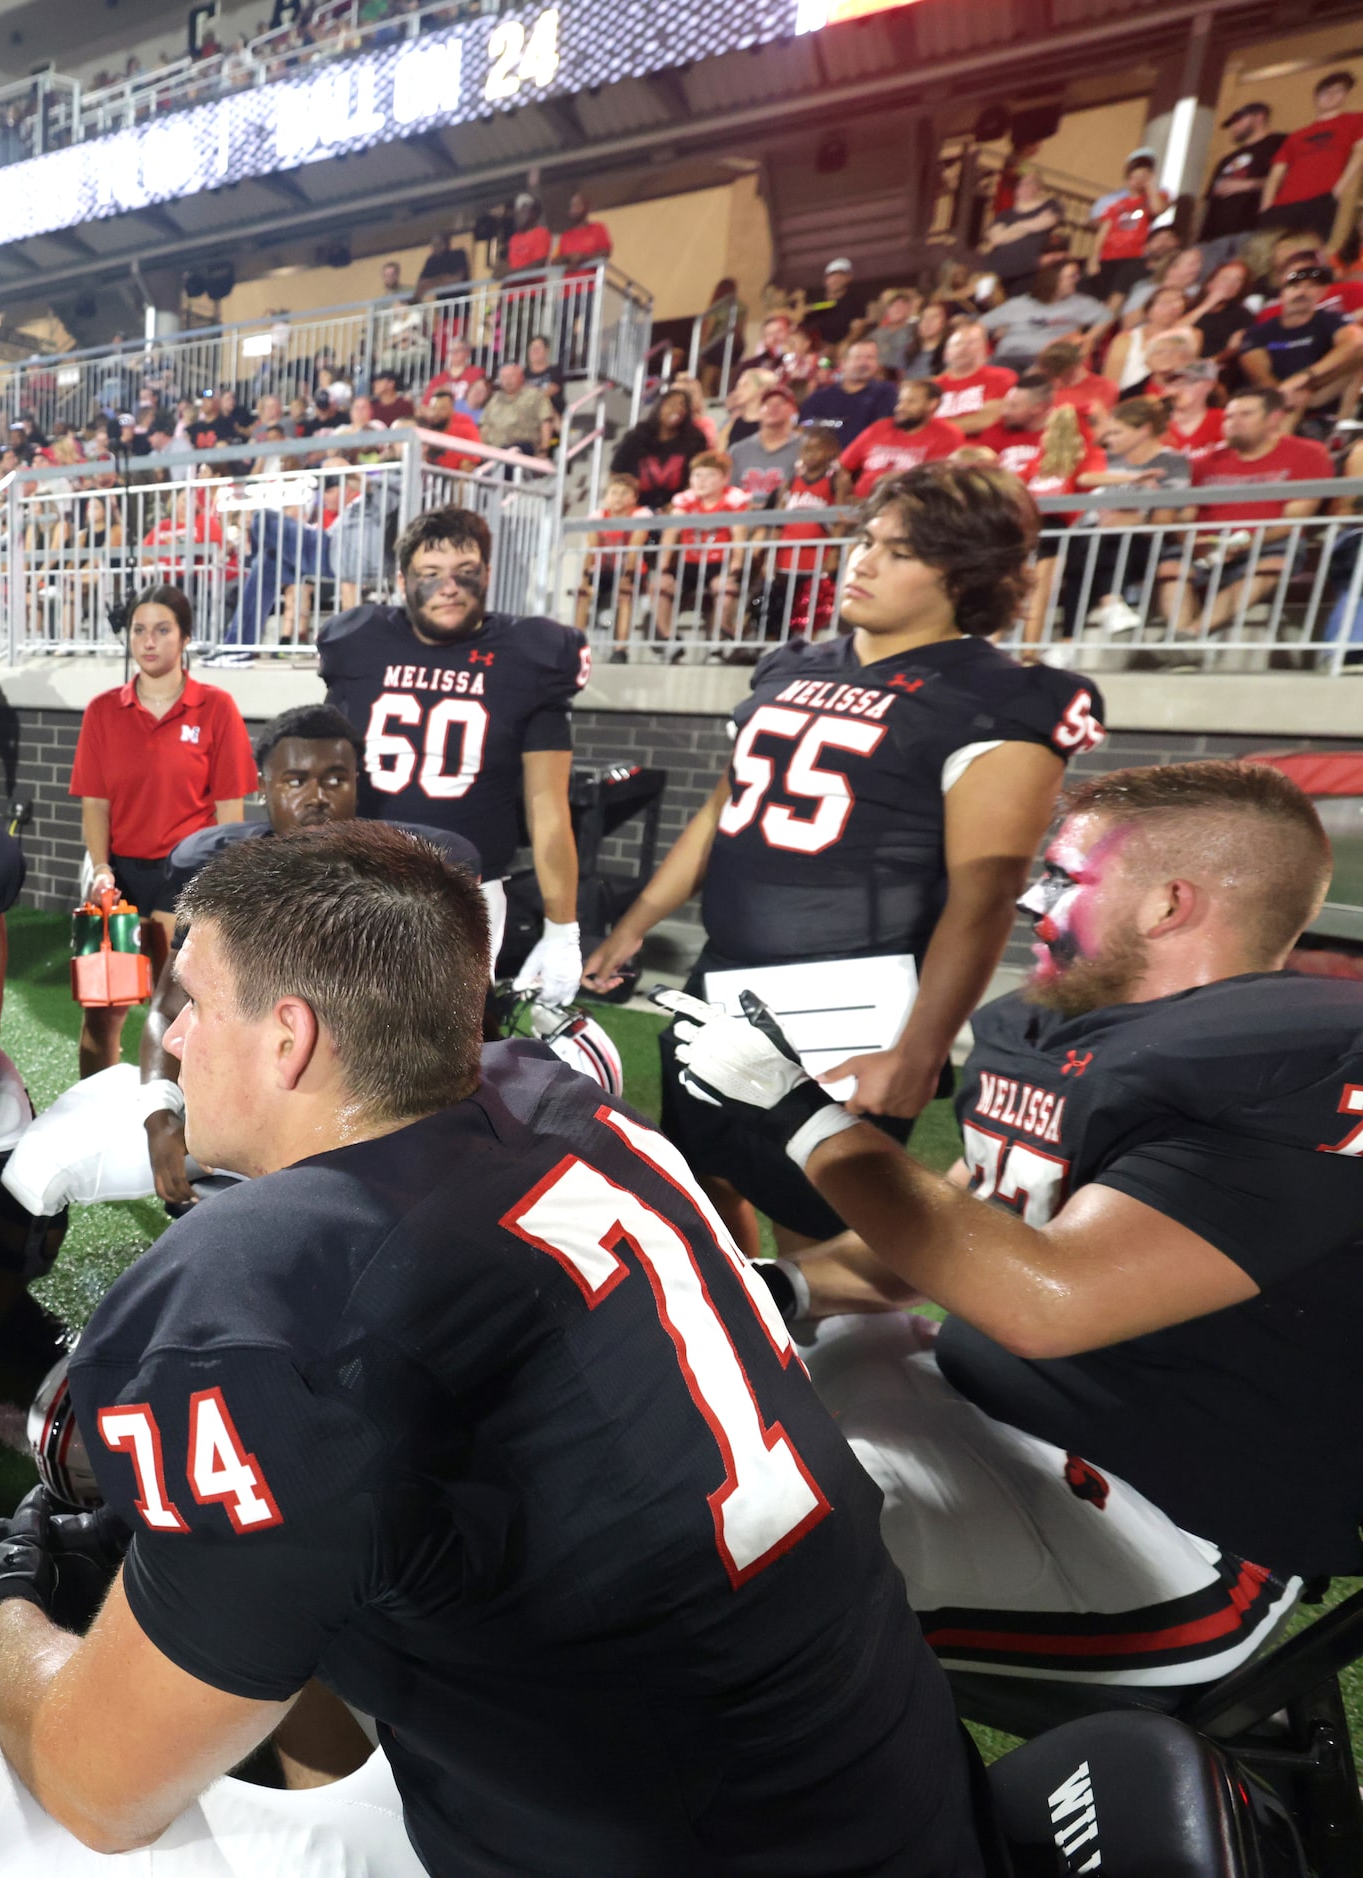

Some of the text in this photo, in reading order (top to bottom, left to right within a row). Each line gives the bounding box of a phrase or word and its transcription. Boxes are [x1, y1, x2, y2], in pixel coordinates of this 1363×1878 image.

[485, 9, 560, 101] 24
[639, 454, 685, 491] M
[383, 664, 485, 696] MELISSA
[774, 678, 899, 720] MELISSA
[364, 692, 490, 799] 60
[718, 703, 889, 857] 55
[974, 1070, 1067, 1145] MELISSA
[96, 1385, 284, 1535] 74
